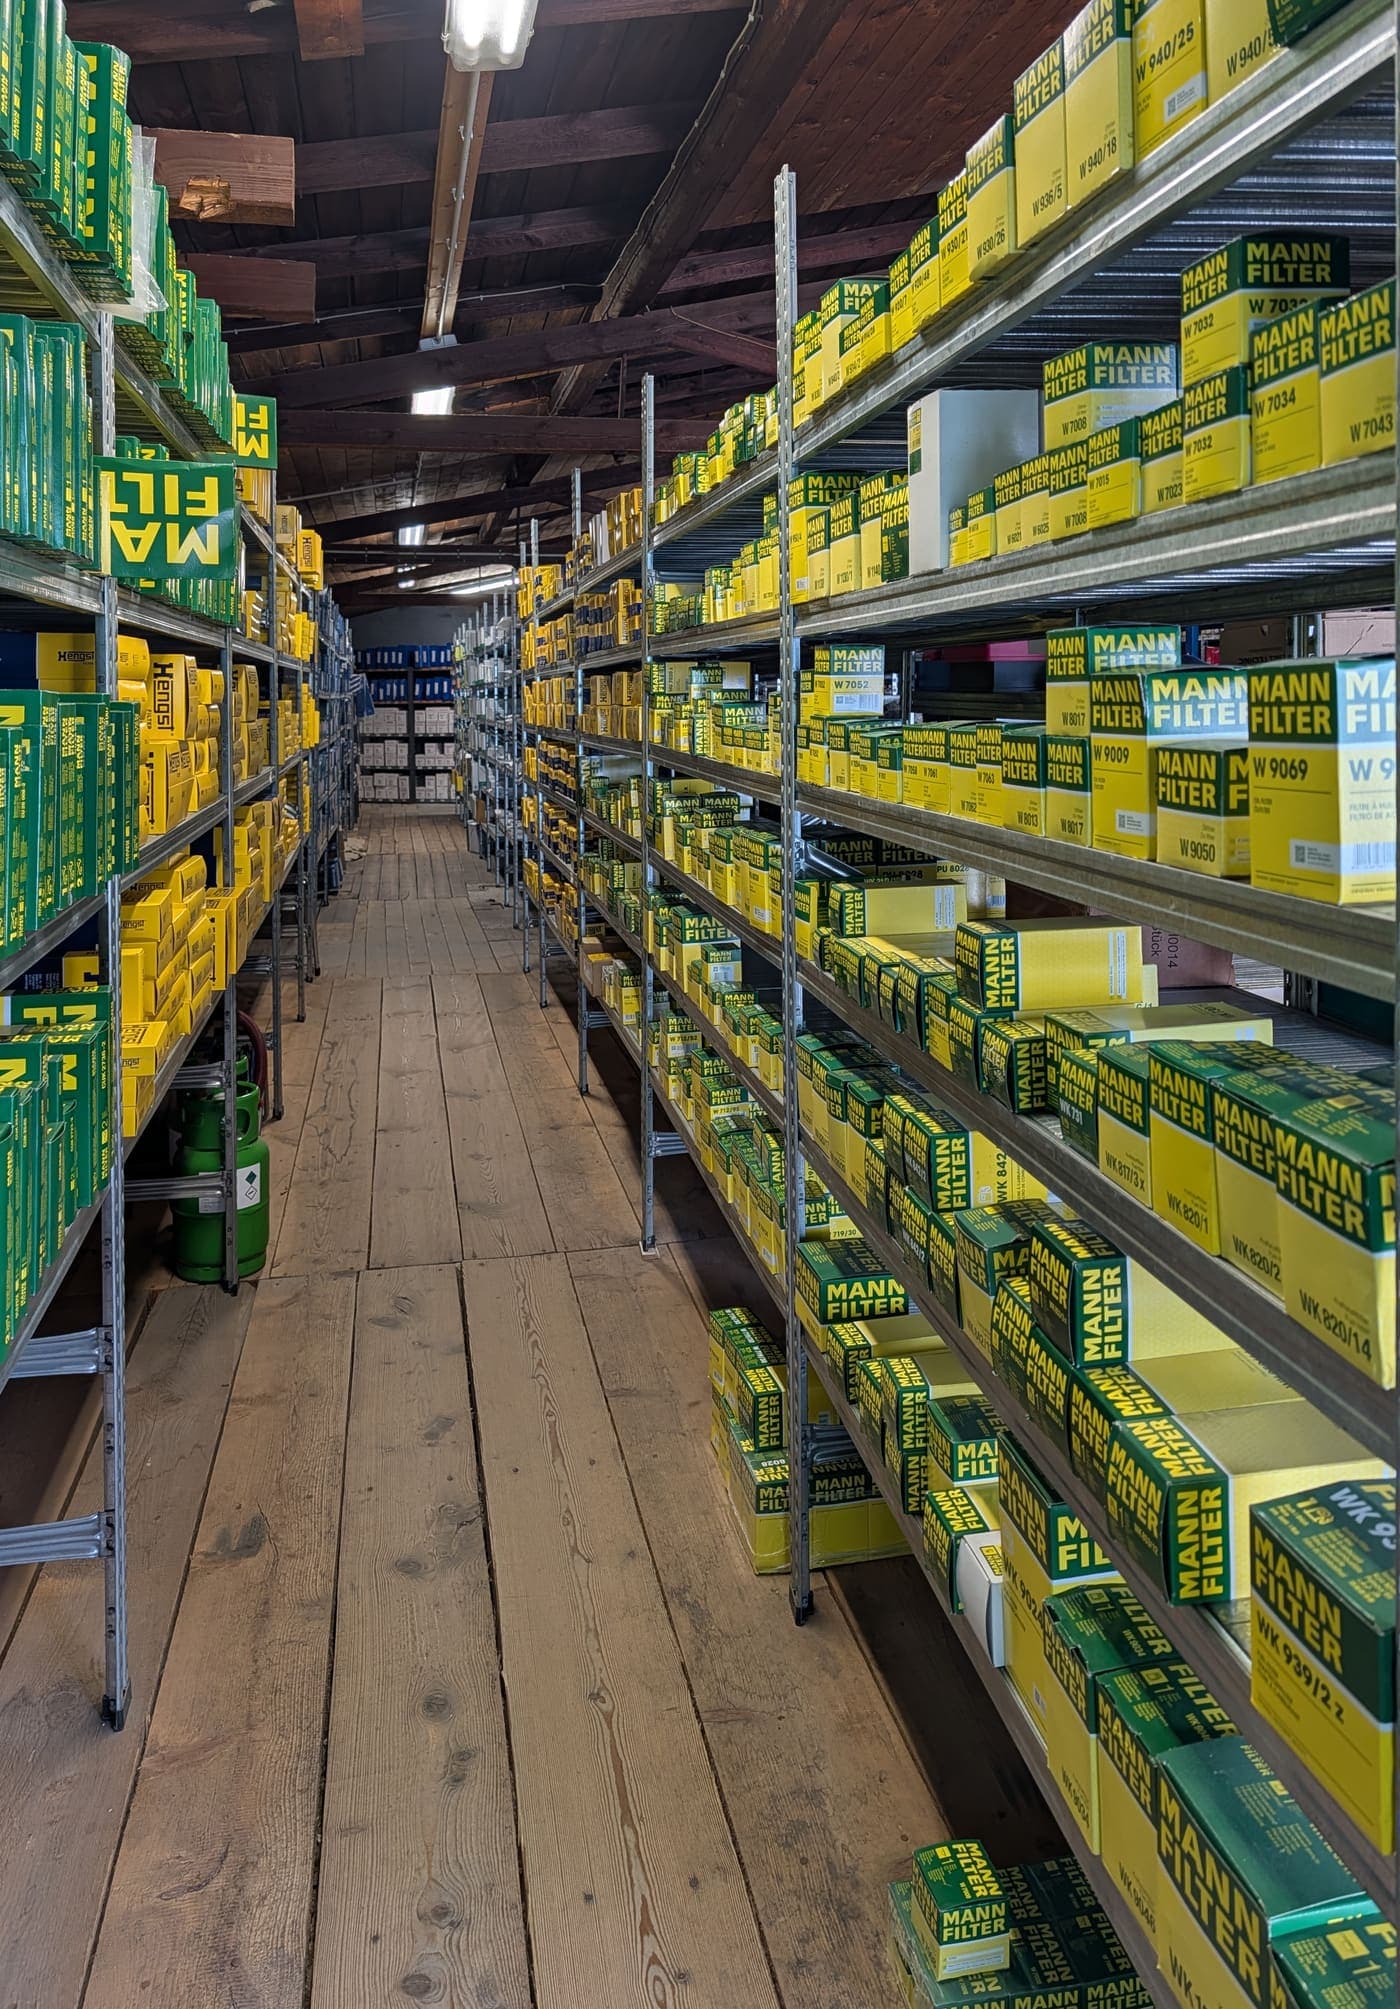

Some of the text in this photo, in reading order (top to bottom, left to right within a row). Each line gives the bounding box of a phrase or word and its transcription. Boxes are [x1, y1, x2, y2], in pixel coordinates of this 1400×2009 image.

[1065, 19, 1114, 77] FILTER
[1136, 22, 1195, 84] W 940/25
[1015, 48, 1061, 99] MANN
[1227, 56, 1238, 77] W
[1016, 73, 1061, 127] FILTER
[1088, 137, 1116, 175] 940/18
[1042, 183, 1062, 210] 936/5
[1247, 243, 1331, 262] MANN
[1248, 264, 1331, 282] FILTER
[1250, 299, 1264, 313] W
[1320, 289, 1391, 345] MANN
[1184, 314, 1214, 339] W 7032
[1254, 309, 1314, 356] MANN
[1094, 346, 1170, 364] MANN
[1322, 319, 1391, 371] FILTER
[1095, 366, 1171, 384] FILTER
[1255, 340, 1314, 386] FILTER
[1256, 388, 1296, 414] W 7034
[1062, 418, 1087, 435] W 7008
[1351, 414, 1393, 442] W 7043
[1185, 436, 1212, 457] W 7032
[697, 457, 707, 494] MANN
[1158, 483, 1182, 502] W 7023
[1065, 512, 1087, 529] W 7008
[834, 650, 881, 661] MANN
[1048, 637, 1084, 656] MANN
[1094, 634, 1176, 651] MANN
[834, 662, 881, 672] FILTER
[845, 680, 868, 688] 7052
[1049, 658, 1084, 676] FILTER
[153, 663, 174, 733] Hengst
[713, 691, 747, 700] MANN
[1092, 679, 1139, 702] MANN
[1251, 672, 1330, 701] MANN
[725, 717, 762, 725] FILTER
[726, 707, 764, 716] MANN
[1062, 712, 1085, 726] W 8017
[1093, 705, 1143, 728] FILTER
[1252, 706, 1331, 734] FILTER
[1002, 743, 1036, 760] MANN
[1048, 742, 1083, 764] MANN
[1094, 746, 1129, 764] W 9009
[1159, 750, 1216, 780] MANN
[924, 766, 929, 776] W
[978, 771, 995, 784] W 7063
[1002, 762, 1037, 782] FILTER
[1049, 766, 1083, 784] FILTER
[1253, 758, 1308, 781] W 9069
[666, 799, 699, 808] MANN
[703, 798, 738, 807] MANN
[961, 801, 977, 813] W 7062
[1160, 778, 1216, 808] FILTER
[703, 812, 733, 821] MANN
[1017, 811, 1038, 827] W 8013
[1061, 818, 1083, 836] W 8017
[1180, 839, 1215, 863] W 9050
[986, 938, 999, 1008] MANN
[1001, 937, 1015, 1007] FILTER
[712, 1088, 740, 1096] MANN
[1017, 1043, 1031, 1108] MANN
[1060, 1061, 1096, 1091] MANN
[1099, 1060, 1144, 1099] MANN
[1150, 1060, 1206, 1107] MANN
[712, 1094, 741, 1103] FILTER
[1060, 1081, 1094, 1114] FILTER
[1060, 1098, 1083, 1126] WK 731
[1100, 1086, 1144, 1127] FILTER
[1151, 1087, 1206, 1134] FILTER
[938, 1138, 950, 1209] MANN
[952, 1137, 966, 1207] FILTER
[996, 1152, 1007, 1202] WK 842
[1105, 1151, 1118, 1174] WK
[1118, 1157, 1139, 1188] 817/3
[1275, 1129, 1362, 1204] MANN
[1167, 1191, 1208, 1234] WK 820/1
[1278, 1162, 1367, 1243] FILTER
[1032, 1236, 1070, 1286] MANN
[1232, 1235, 1281, 1283] WK 820/2
[828, 1279, 904, 1297] MANN
[828, 1301, 904, 1319] FILTER
[1084, 1270, 1100, 1361] MANN
[1103, 1266, 1121, 1359] FILTER
[1300, 1289, 1372, 1362] WK 820/14
[1029, 1338, 1067, 1390] MANN
[1027, 1366, 1065, 1417] FILTER
[1109, 1365, 1164, 1414] FILTER
[759, 1396, 768, 1448] MANN
[1128, 1421, 1183, 1478] MANN
[1149, 1418, 1215, 1475] FILTER
[1000, 1452, 1046, 1531] MANN
[1112, 1441, 1163, 1511] MANN
[1108, 1470, 1160, 1543] FILTER
[1000, 1481, 1047, 1570] FILTER
[1201, 1487, 1224, 1595] FILTER
[1178, 1490, 1199, 1599] MANN
[1255, 1527, 1342, 1638] MANN
[1111, 1587, 1173, 1655] FILTER
[1255, 1562, 1343, 1676] FILTER
[1256, 1610, 1281, 1648] WK
[1282, 1643, 1333, 1706] 939/2
[1099, 1691, 1152, 1782] MANN
[1099, 1719, 1152, 1817] FILTER
[952, 1843, 987, 1898] FILTER
[965, 1842, 1002, 1896] MANN
[1160, 1774, 1260, 1955] MANN
[943, 1903, 1006, 1928] MANN
[1160, 1821, 1261, 2000] FILTER
[943, 1918, 1005, 1942] FILTER
[1092, 1913, 1131, 1971] FILTER
[1038, 1923, 1075, 1982] MANN
